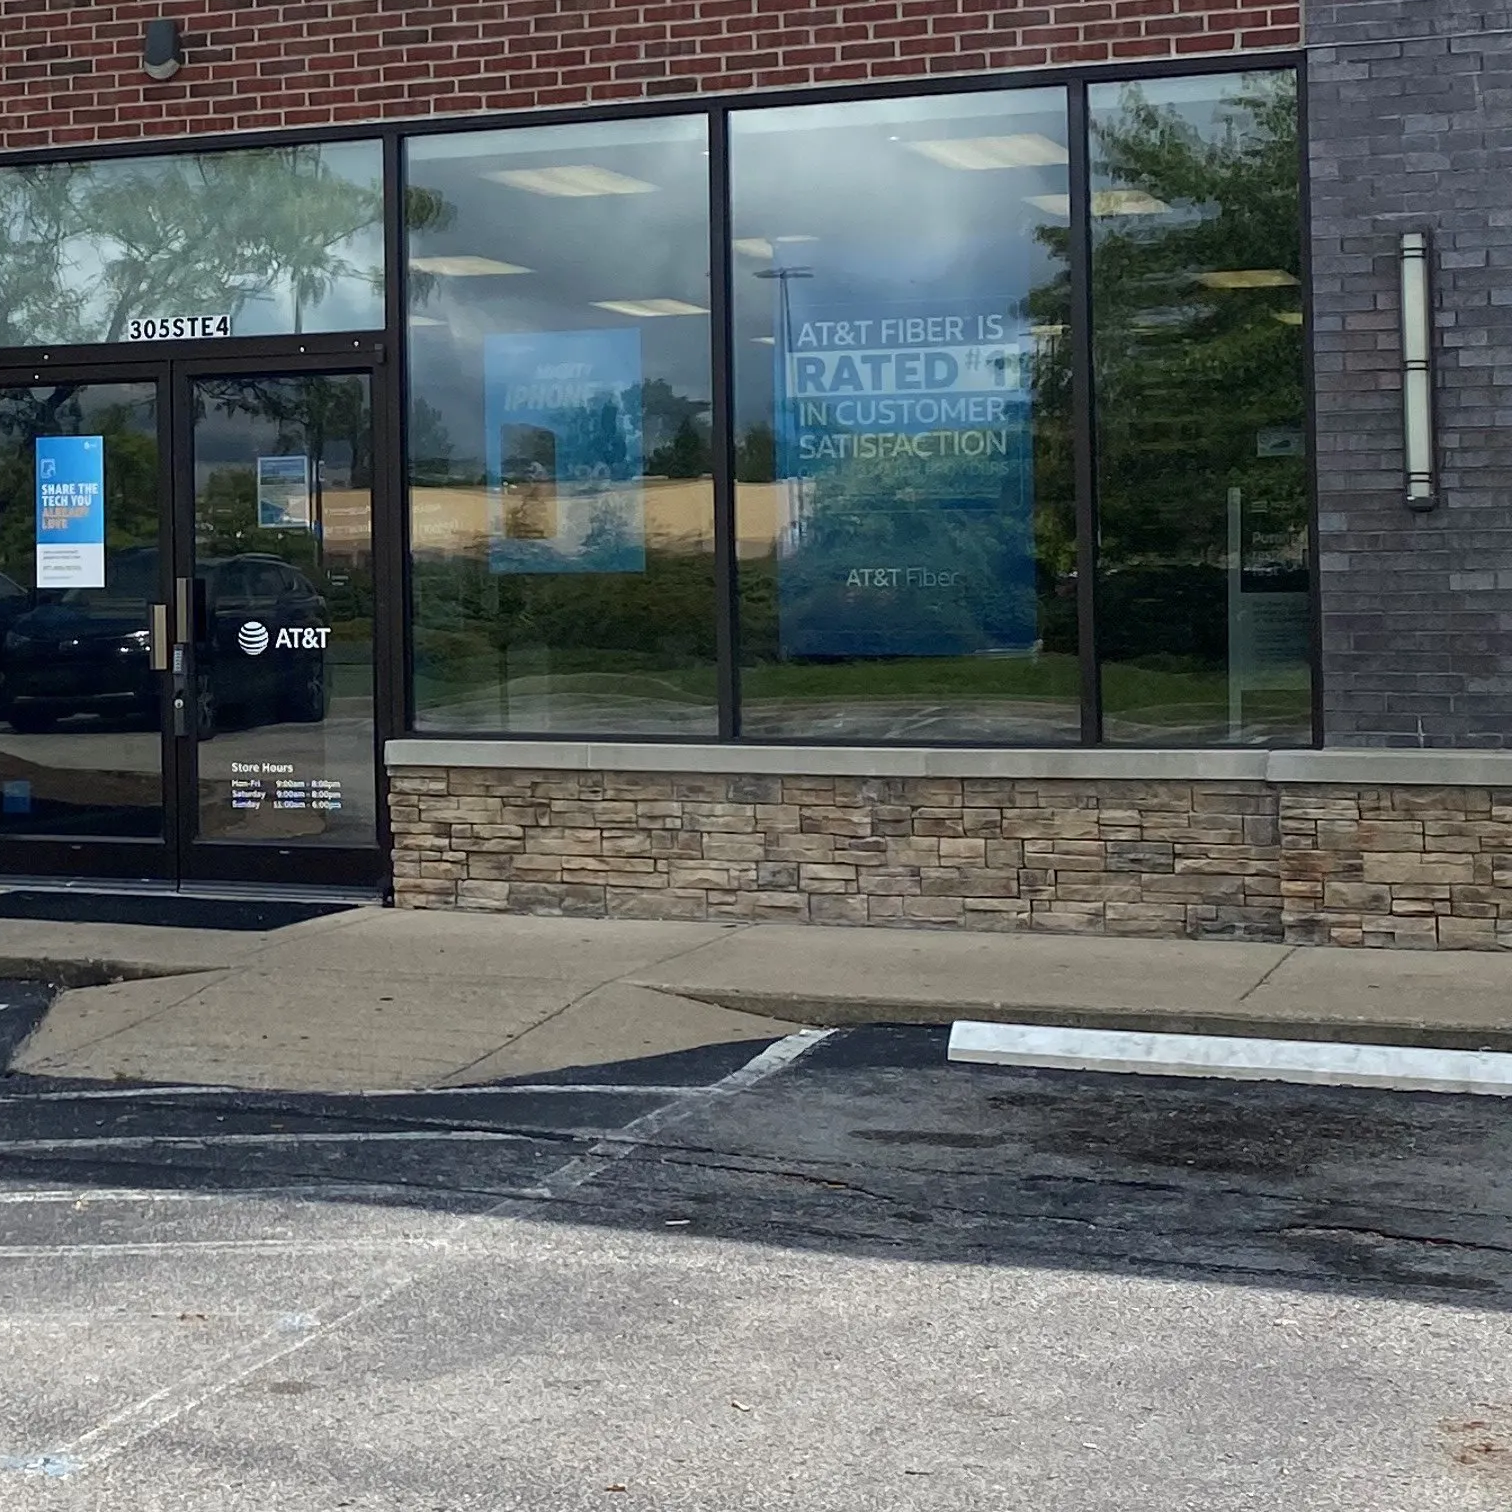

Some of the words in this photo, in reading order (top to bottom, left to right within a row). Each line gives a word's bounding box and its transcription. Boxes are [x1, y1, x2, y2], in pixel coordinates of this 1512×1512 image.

[130, 317, 229, 340] 305STE4
[797, 320, 874, 347] AT&T
[881, 316, 963, 344] FIBER
[978, 314, 1003, 340] IS
[797, 350, 959, 394] RATED
[799, 399, 828, 427] IN
[835, 397, 1006, 426] CUSTOMER
[799, 429, 1007, 460] SATISFACTION
[41, 483, 76, 495] SHARE
[77, 482, 99, 495] THE
[42, 495, 68, 507] TECH
[70, 494, 92, 506] YOU
[847, 568, 901, 587] AT&T
[908, 567, 958, 587] Fiber
[275, 626, 331, 649] AT&T
[231, 762, 260, 773] Store
[262, 762, 294, 773] Hours
